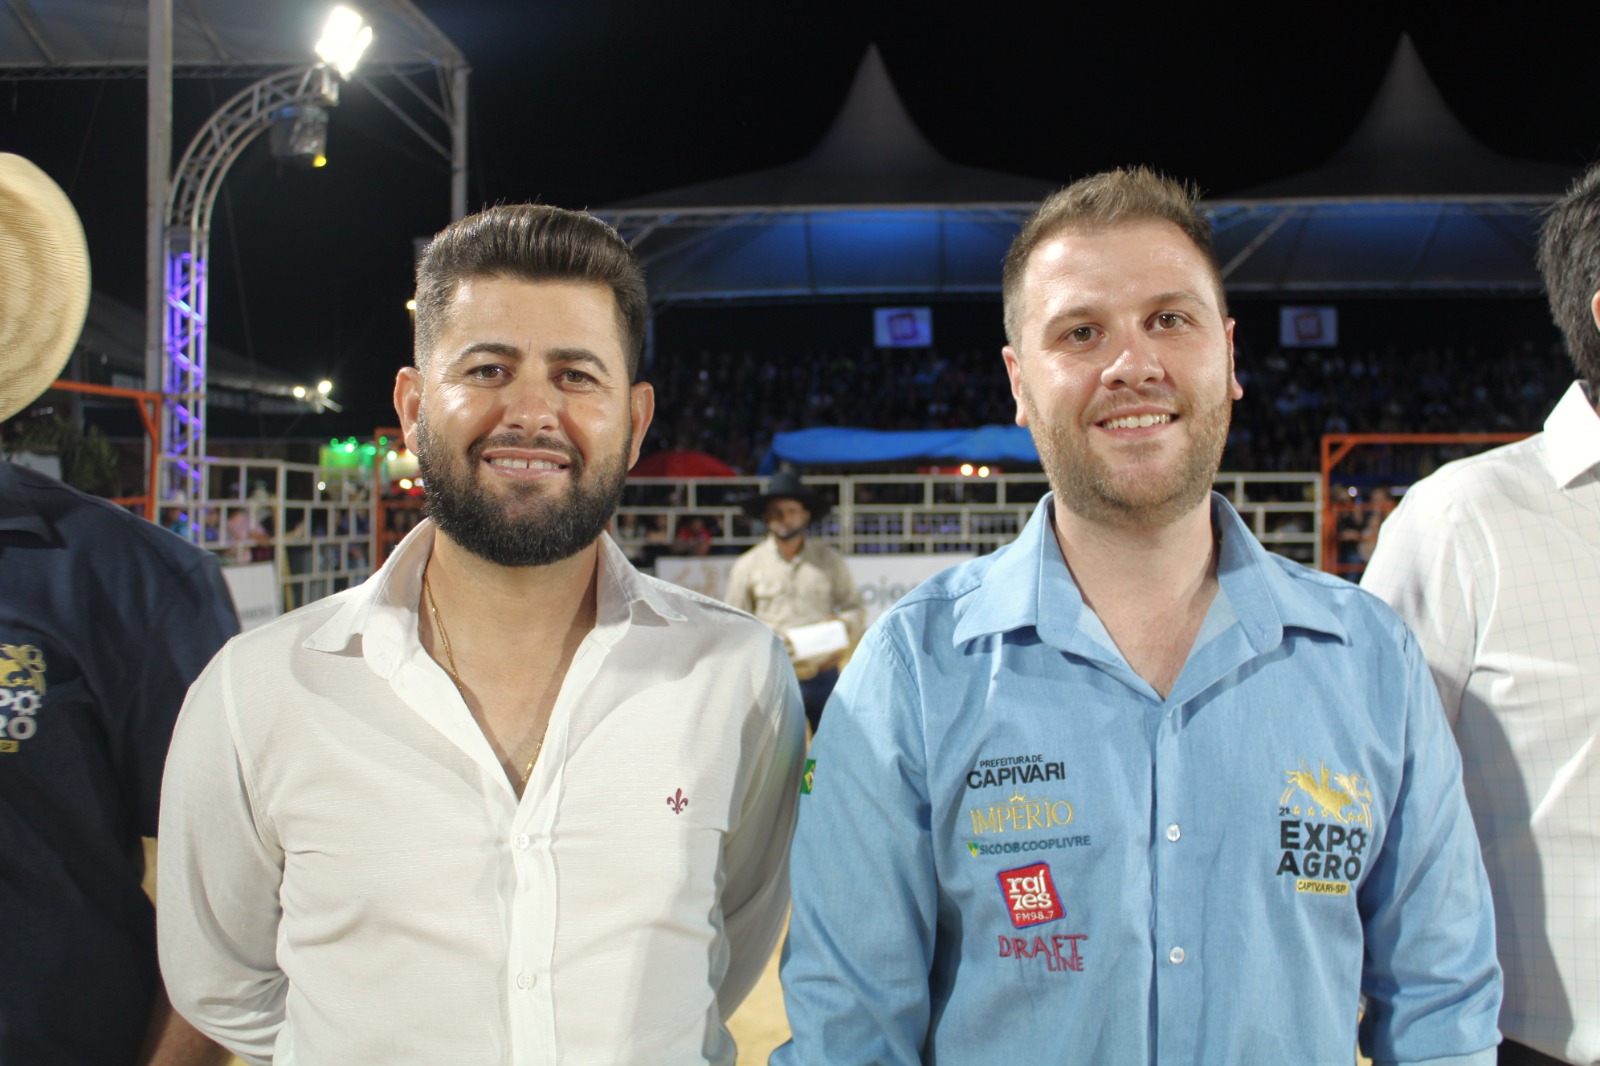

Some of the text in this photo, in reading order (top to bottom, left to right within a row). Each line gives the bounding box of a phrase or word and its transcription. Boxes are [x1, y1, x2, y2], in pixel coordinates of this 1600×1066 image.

[980, 754, 1043, 768] PREFEITURA DE
[966, 761, 1065, 789] CAPIVARI
[1280, 820, 1367, 855] EXPO
[1276, 850, 1361, 881] AGRO
[1009, 892, 1053, 911] zes
[998, 933, 1088, 960] DRAFT
[1047, 955, 1085, 972] LINE
